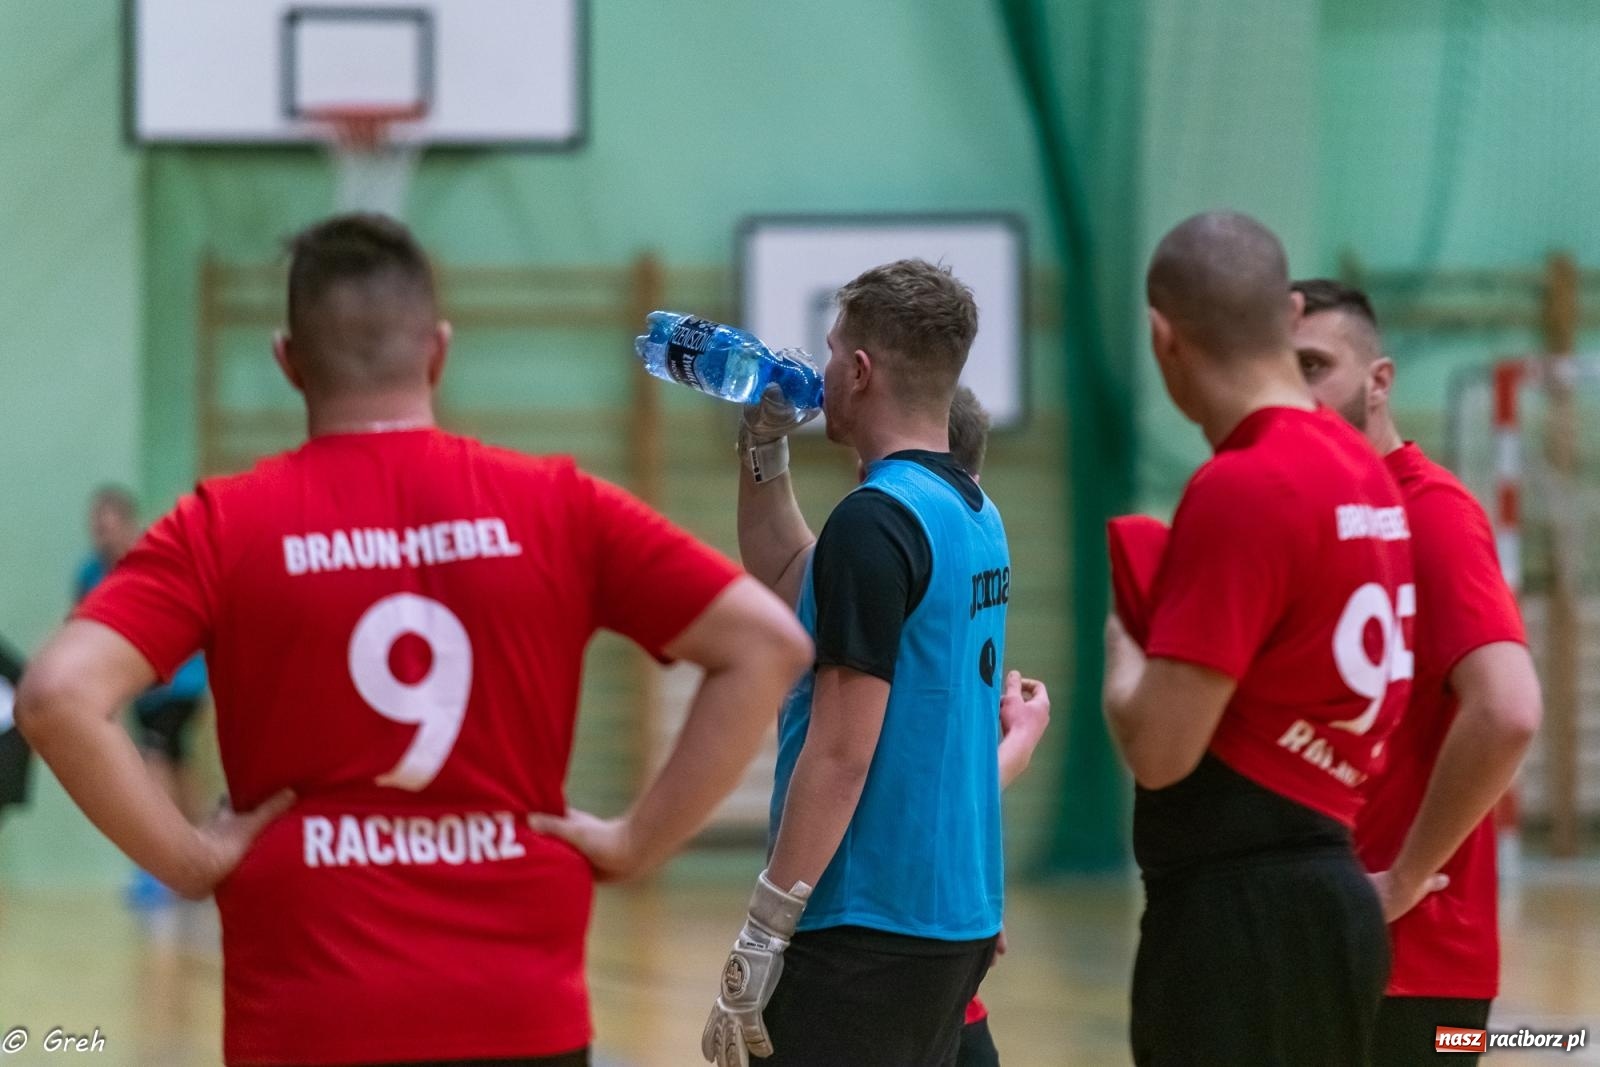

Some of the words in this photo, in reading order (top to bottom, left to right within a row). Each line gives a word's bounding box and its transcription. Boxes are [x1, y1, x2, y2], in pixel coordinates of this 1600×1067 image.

[283, 517, 523, 576] BRAUN-MEBEL
[347, 591, 473, 793] 9
[303, 811, 526, 868] RACIBORZ
